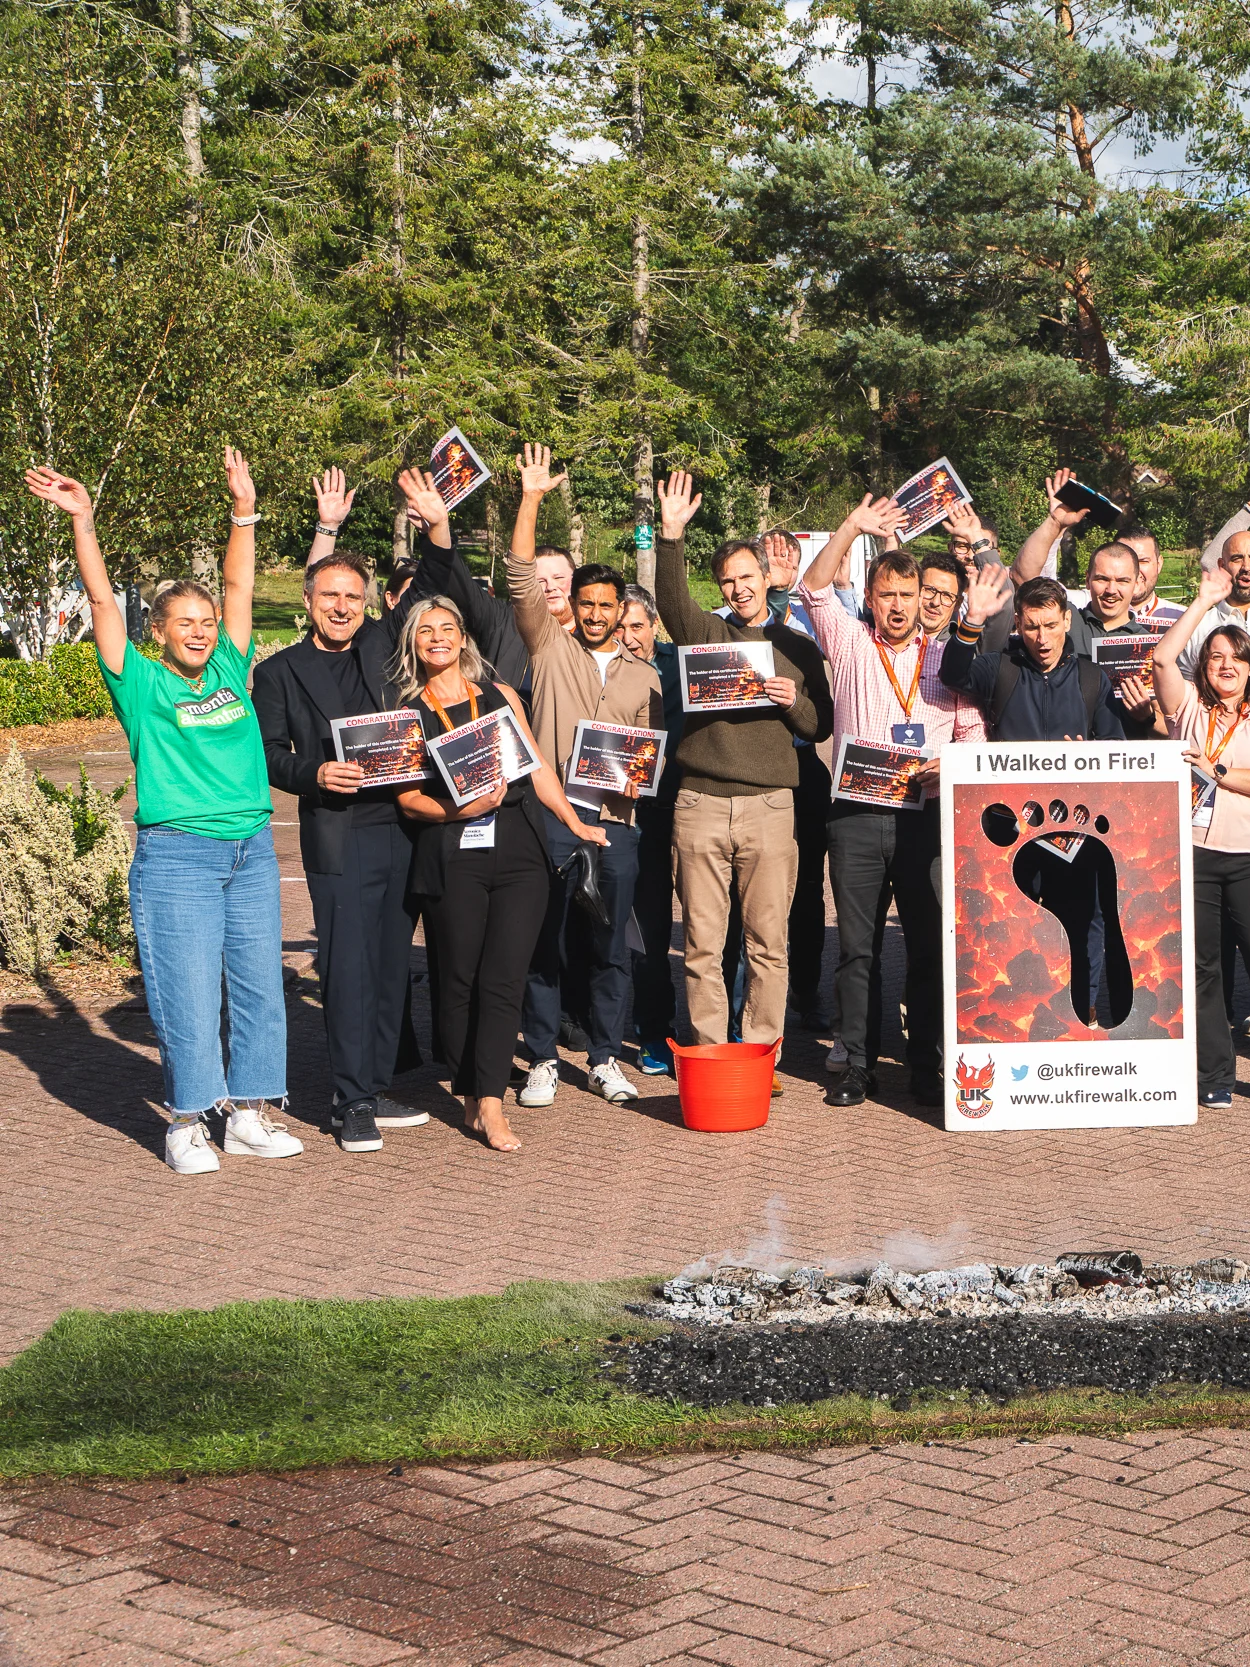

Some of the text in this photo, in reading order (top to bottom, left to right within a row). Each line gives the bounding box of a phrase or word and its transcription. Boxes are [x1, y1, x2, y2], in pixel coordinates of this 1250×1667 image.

[186, 689, 236, 715] mentia
[347, 712, 416, 726] CONGRATULATIONS
[591, 723, 656, 738] CONGRATULATIONS
[855, 739, 921, 756] CONGRATULATIONS
[977, 753, 1155, 772] I Walked on Fire!
[1037, 1062, 1137, 1081] @ukfirewalk
[960, 1089, 992, 1101] UK
[1010, 1089, 1177, 1105] www.ukfirewalk.com
[960, 1104, 991, 1117] FIREWALK
